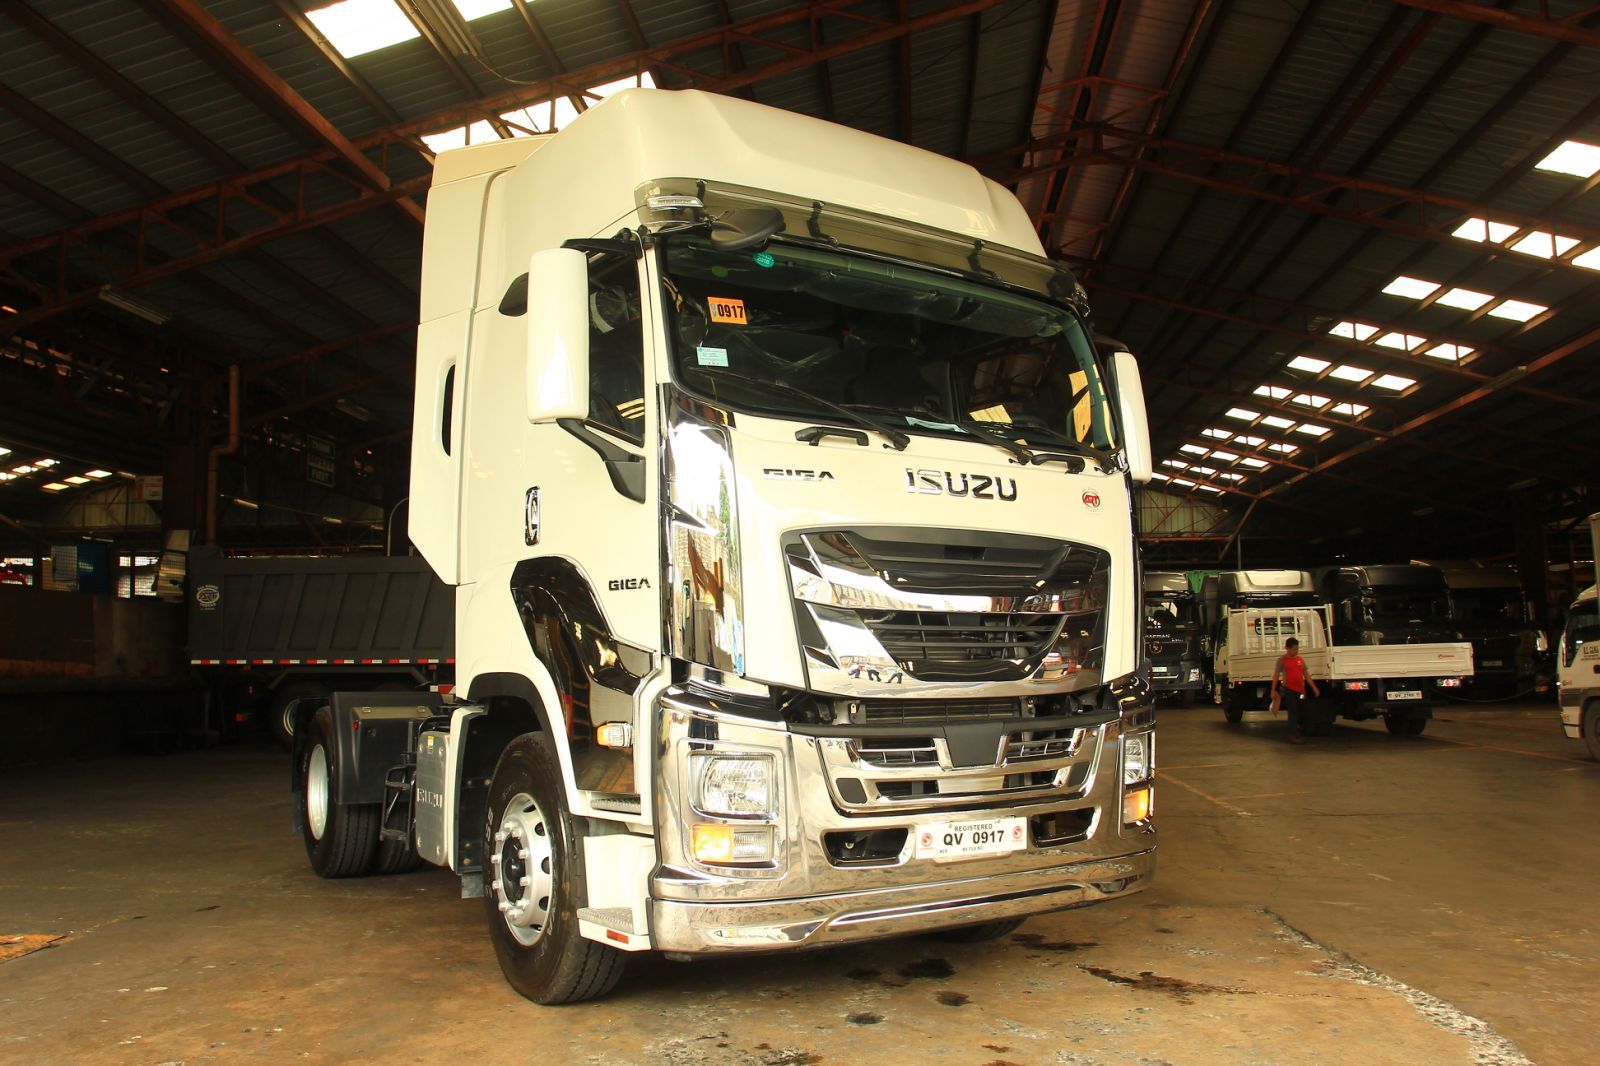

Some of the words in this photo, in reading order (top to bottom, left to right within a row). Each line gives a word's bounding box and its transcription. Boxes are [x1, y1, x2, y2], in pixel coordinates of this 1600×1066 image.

[718, 304, 743, 318] 0917
[763, 467, 835, 482] GIGA
[905, 467, 1018, 502] ISUZU
[608, 577, 651, 591] GIGA
[943, 833, 963, 845] QV
[973, 831, 1004, 844] 0917
